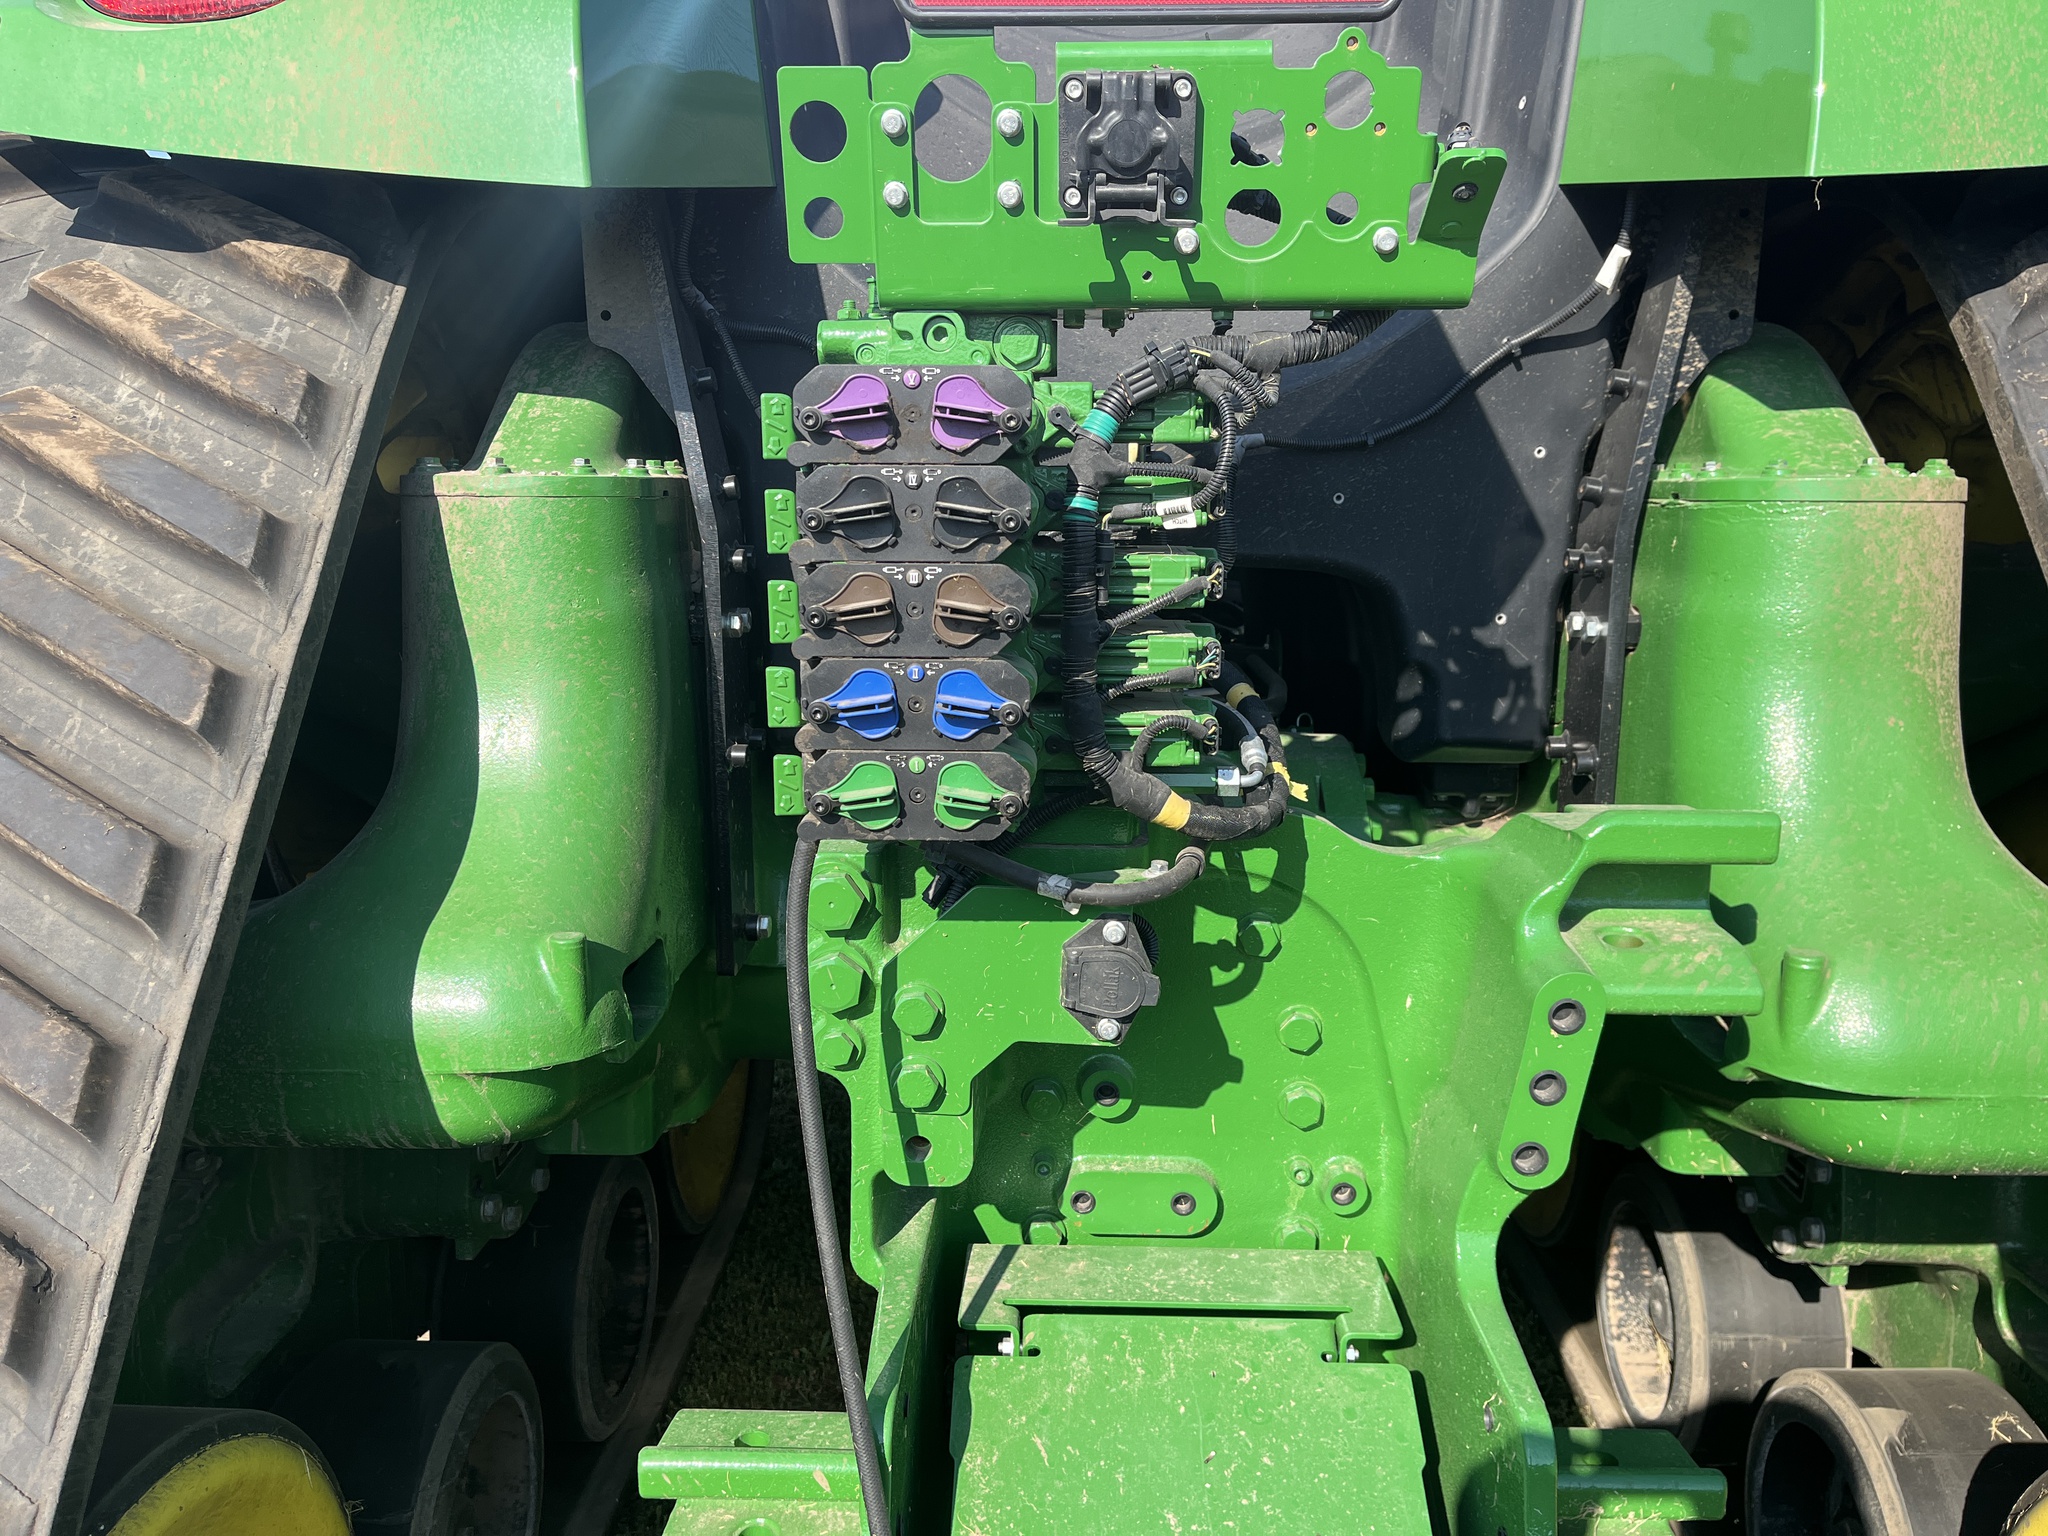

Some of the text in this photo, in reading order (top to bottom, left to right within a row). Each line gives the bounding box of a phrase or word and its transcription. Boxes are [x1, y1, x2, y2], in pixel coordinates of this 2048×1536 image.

[907, 373, 917, 385] V
[908, 474, 918, 485] IV
[909, 572, 919, 584] III
[912, 668, 919, 679] II
[1102, 966, 1120, 1009] Pollak
